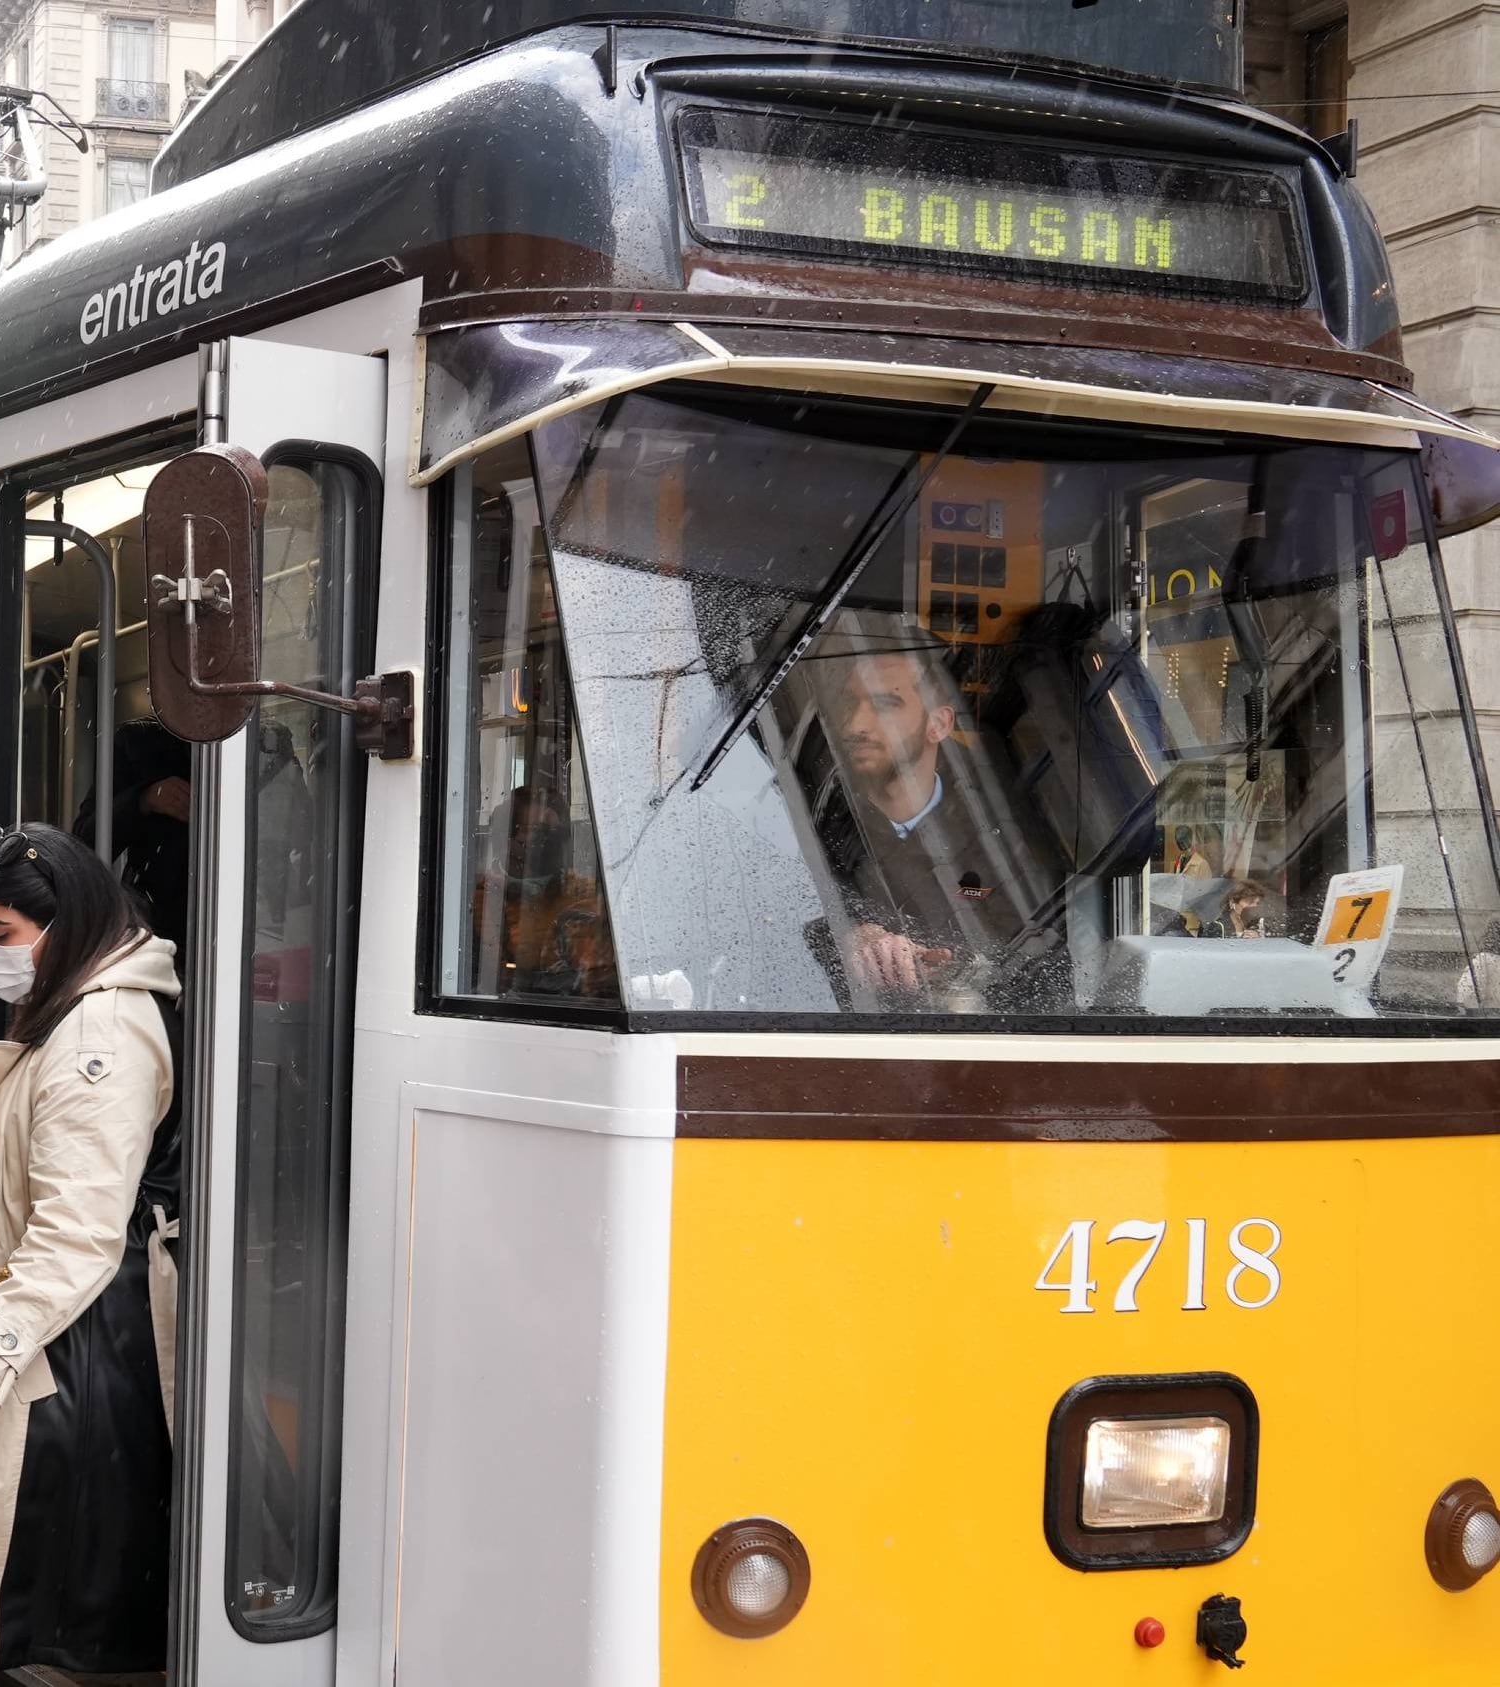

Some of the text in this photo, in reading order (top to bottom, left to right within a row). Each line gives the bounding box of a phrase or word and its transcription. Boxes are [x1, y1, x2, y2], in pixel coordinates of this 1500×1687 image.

[724, 174, 1174, 269] 2 BAUSAN
[79, 240, 227, 345] entrata
[1332, 947, 1357, 983] 2
[1351, 897, 1373, 939] 7
[1033, 1217, 1282, 1314] 4718
